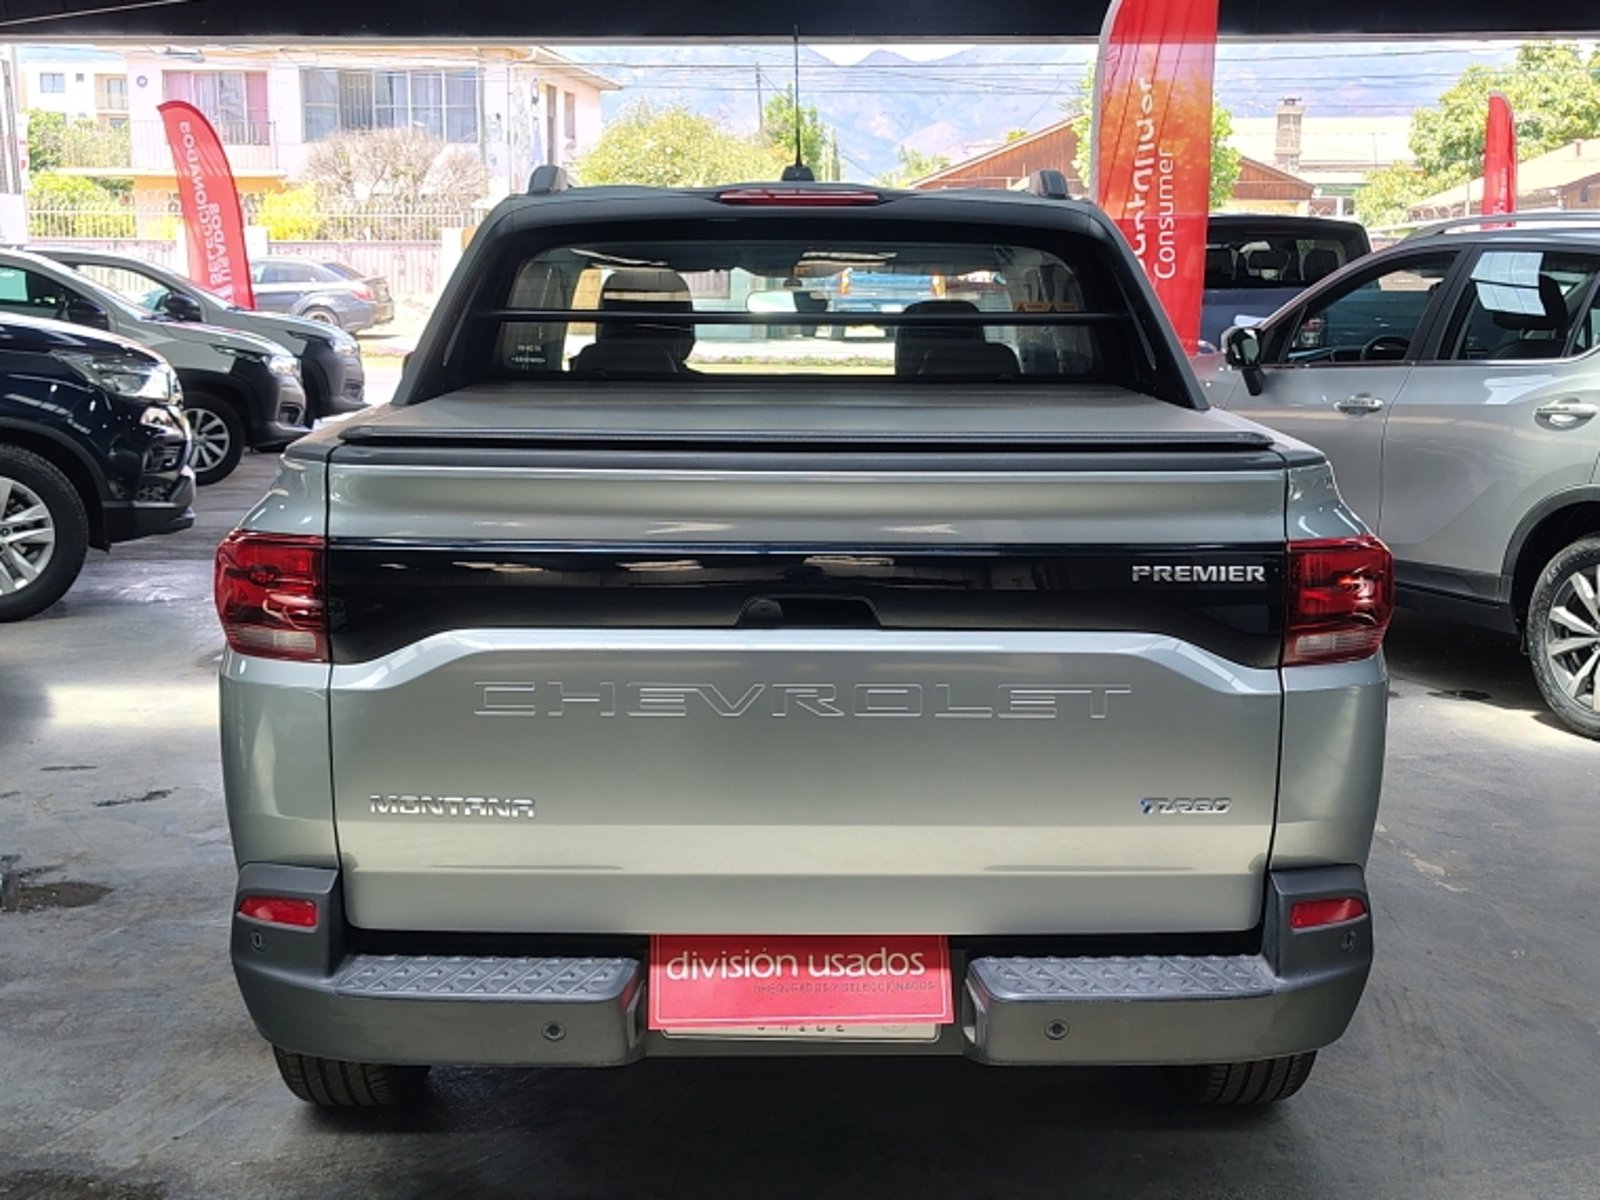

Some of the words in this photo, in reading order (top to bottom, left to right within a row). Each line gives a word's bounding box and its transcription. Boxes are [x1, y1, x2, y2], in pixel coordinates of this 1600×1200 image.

[1126, 77, 1155, 273] antander
[1153, 150, 1176, 280] Consumer
[1132, 565, 1266, 583] PREMIER
[473, 680, 1132, 719] CHEVROLET
[369, 794, 535, 819] MONTANA
[1140, 797, 1232, 815] TURBO
[665, 947, 799, 980] división
[808, 947, 926, 977] usados
